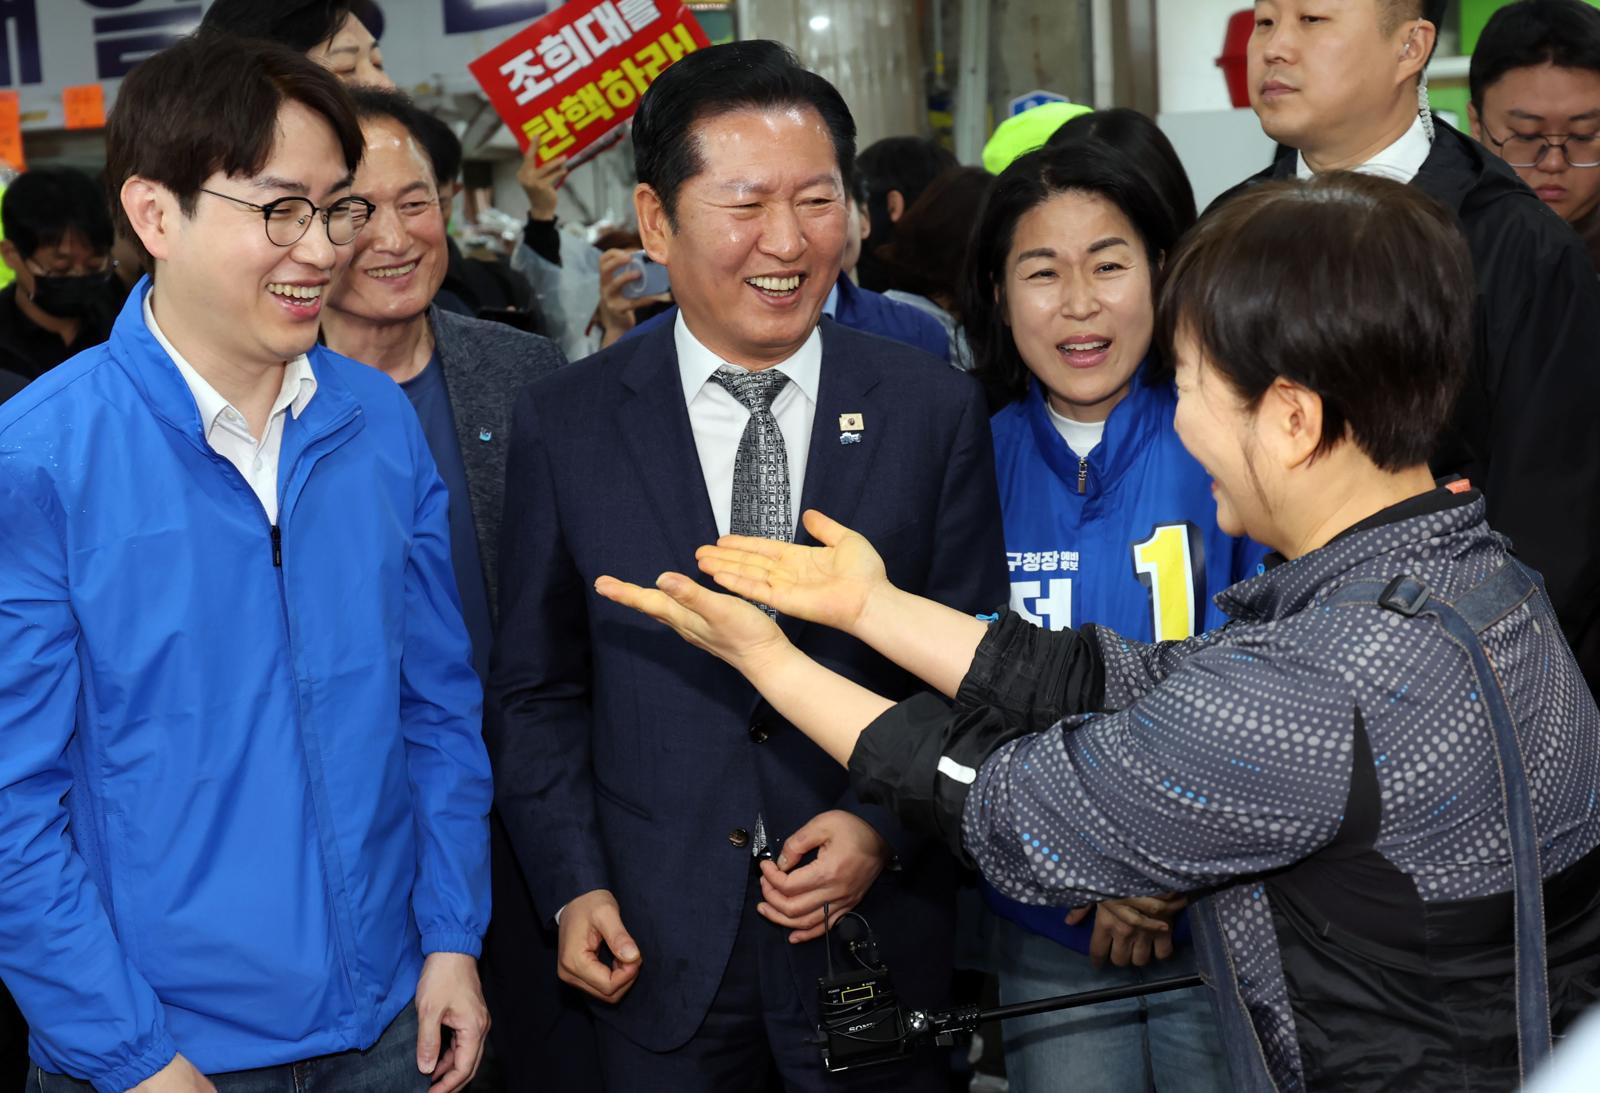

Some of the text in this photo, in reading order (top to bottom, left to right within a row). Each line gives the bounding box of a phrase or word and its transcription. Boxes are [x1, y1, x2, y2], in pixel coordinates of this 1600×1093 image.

[499, 0, 662, 106] 조희대를
[1006, 551, 1060, 572] 구청장
[1134, 524, 1195, 642] 1
